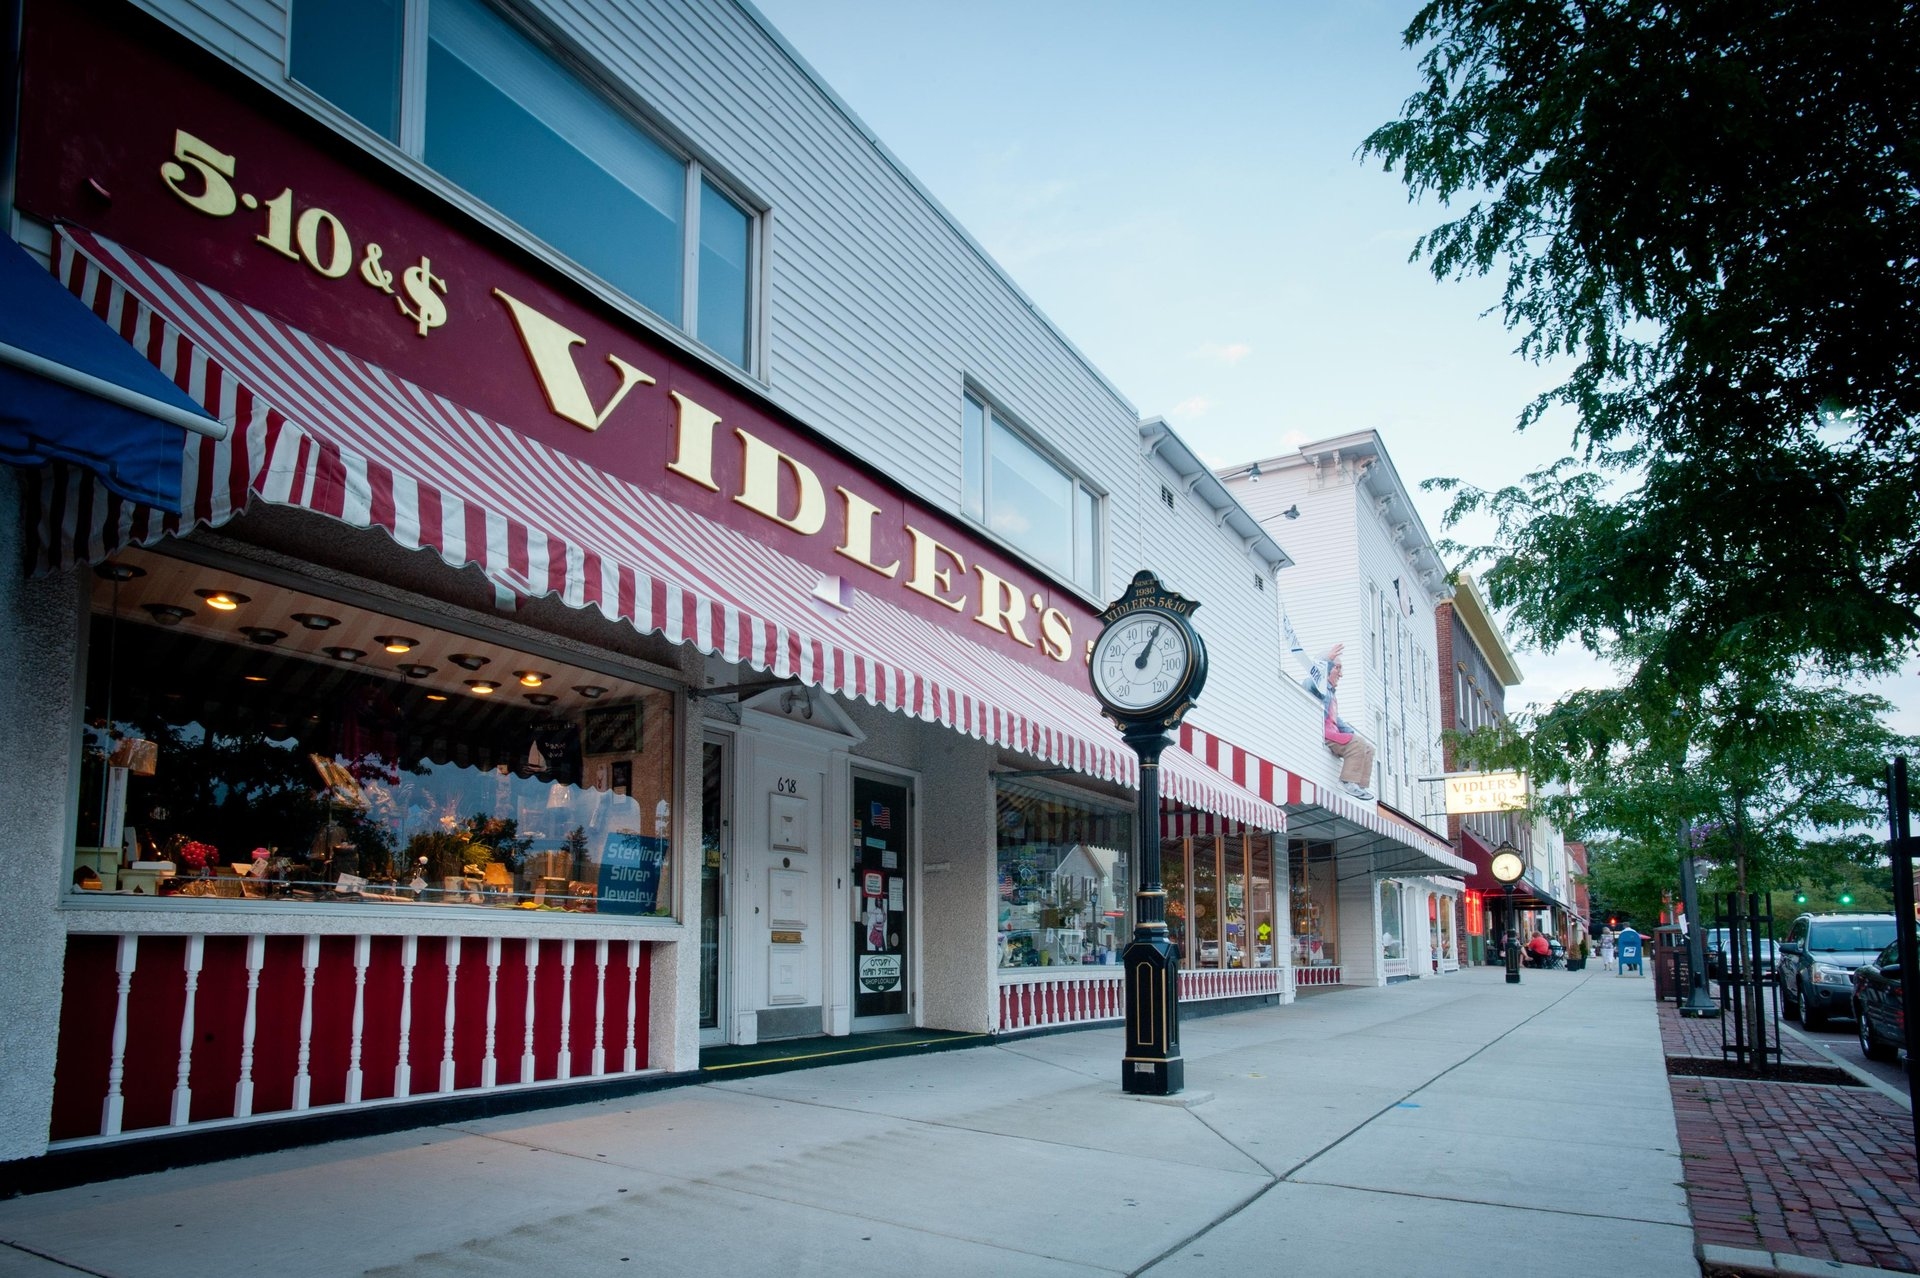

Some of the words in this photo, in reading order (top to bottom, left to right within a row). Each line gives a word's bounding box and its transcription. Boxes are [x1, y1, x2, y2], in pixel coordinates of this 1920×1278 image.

[492, 287, 1074, 663] VIDLER'S
[1134, 579, 1155, 587] SINCE
[1136, 587, 1155, 596] 1930
[1105, 597, 1156, 622] VIDLER'S
[1157, 597, 1186, 613] 5&10
[1126, 628, 1138, 641] 40
[1164, 637, 1175, 650] 80
[1109, 645, 1121, 658] 20
[1166, 657, 1181, 671] 100
[1109, 666, 1115, 678] 0
[1152, 680, 1169, 693] 120
[1452, 778, 1518, 793] VIDLER'S
[1465, 794, 1473, 805] 5
[1479, 795, 1487, 804] &
[1492, 792, 1507, 802] 10
[607, 843, 662, 866] Sterling
[610, 865, 650, 882] Silver
[601, 886, 655, 906] Jewelry
[877, 967, 898, 976] STREET
[878, 977, 896, 985] LOCALLY
